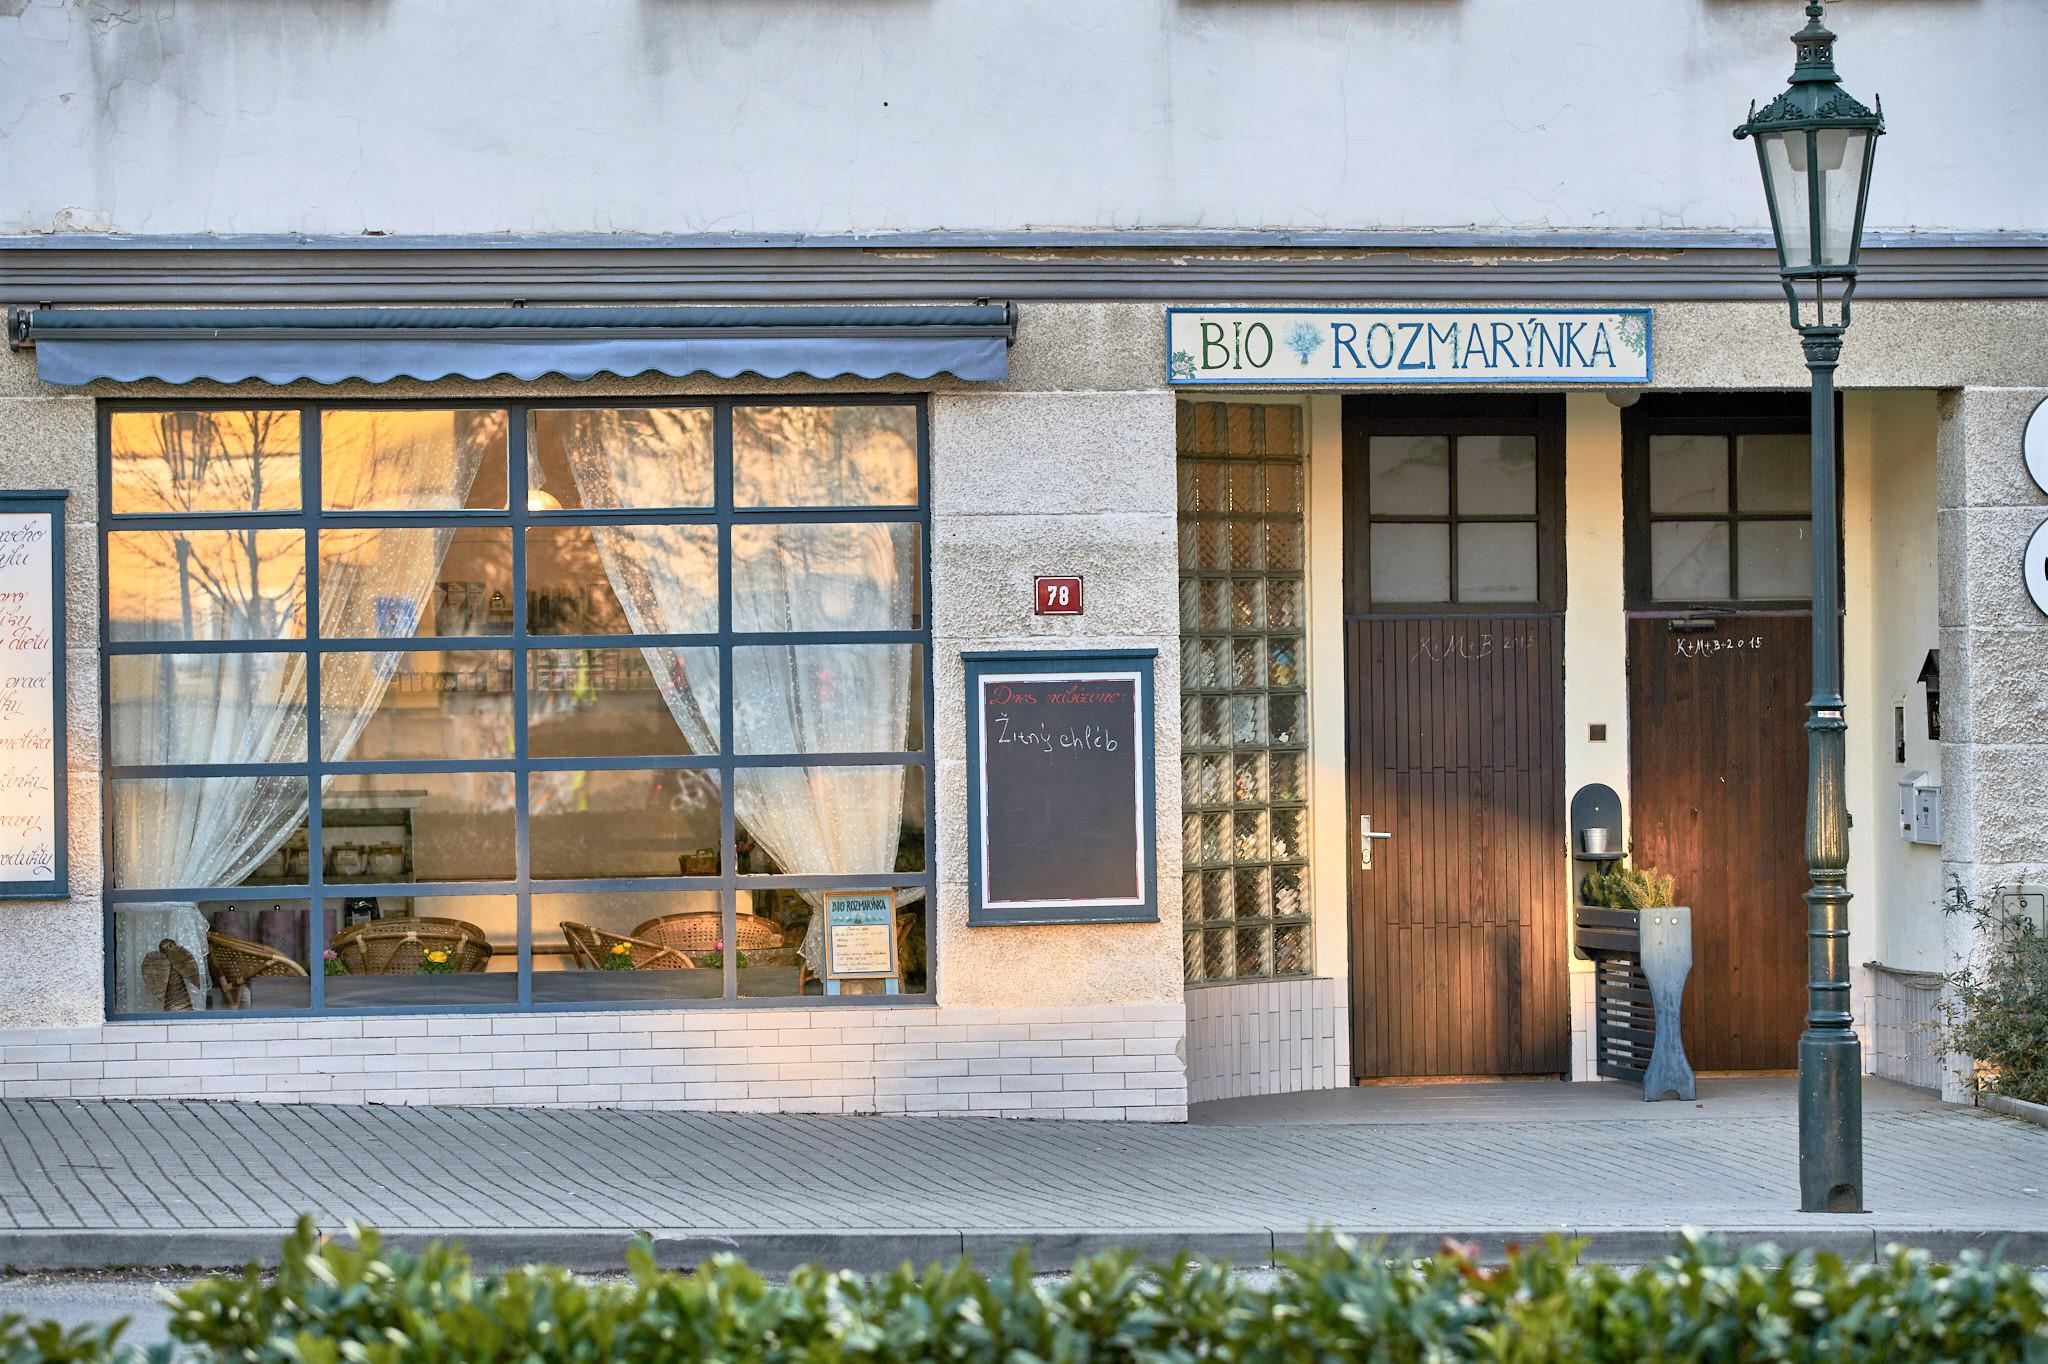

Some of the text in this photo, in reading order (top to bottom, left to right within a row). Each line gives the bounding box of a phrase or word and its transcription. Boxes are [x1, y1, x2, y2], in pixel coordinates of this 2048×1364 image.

[1200, 318, 1616, 370] BIO ROZMARÝNKA
[1047, 585, 1069, 606] 78
